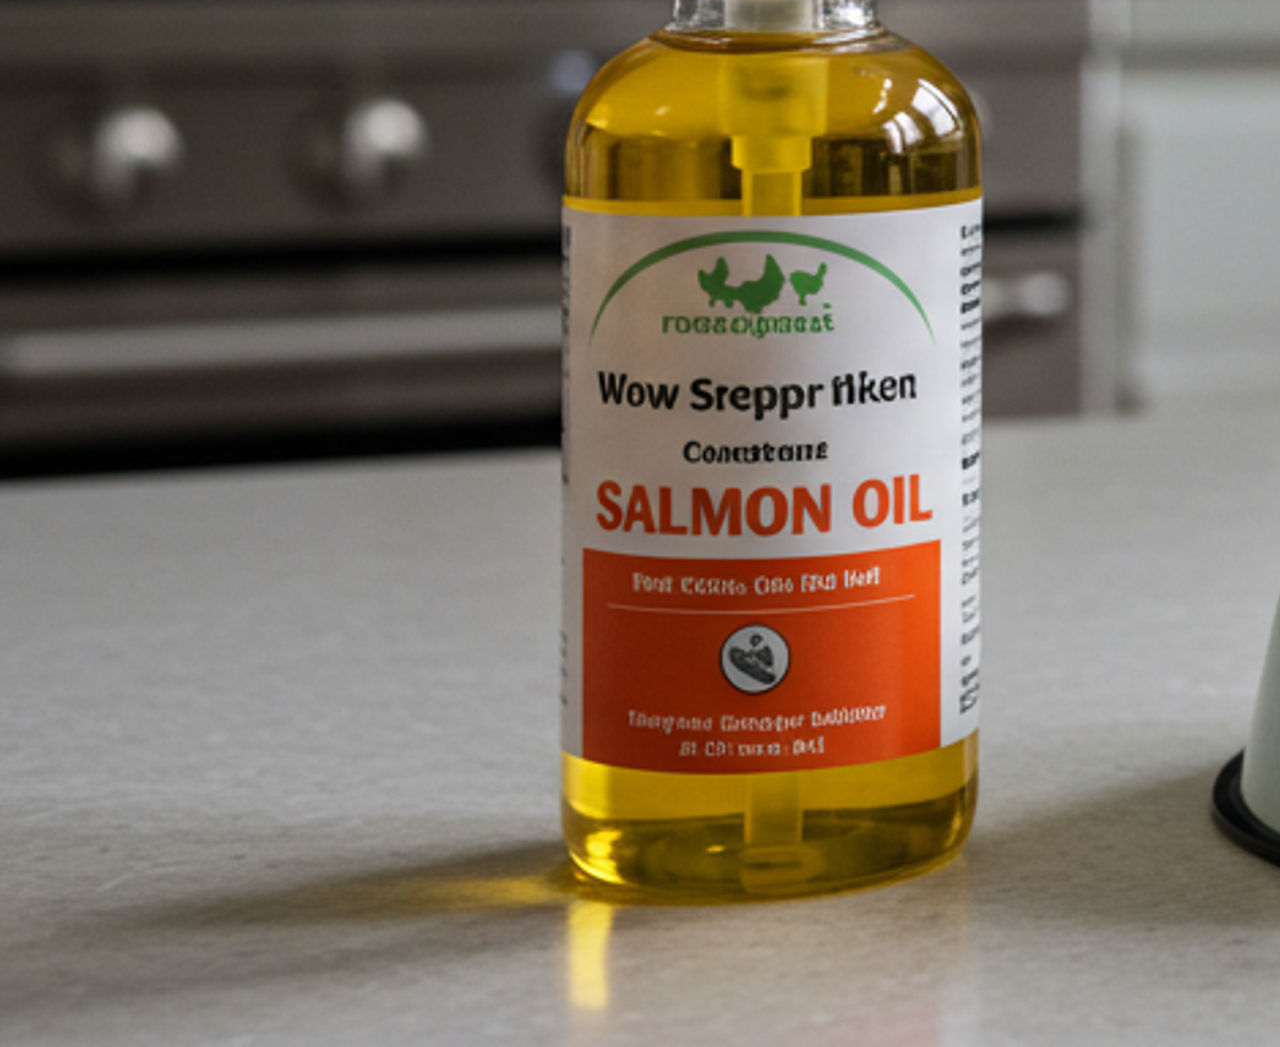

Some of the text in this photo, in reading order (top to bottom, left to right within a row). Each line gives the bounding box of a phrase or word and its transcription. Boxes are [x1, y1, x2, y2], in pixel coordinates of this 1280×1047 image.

[598, 371, 679, 409] Wow
[597, 474, 933, 537] SALMON OIL
